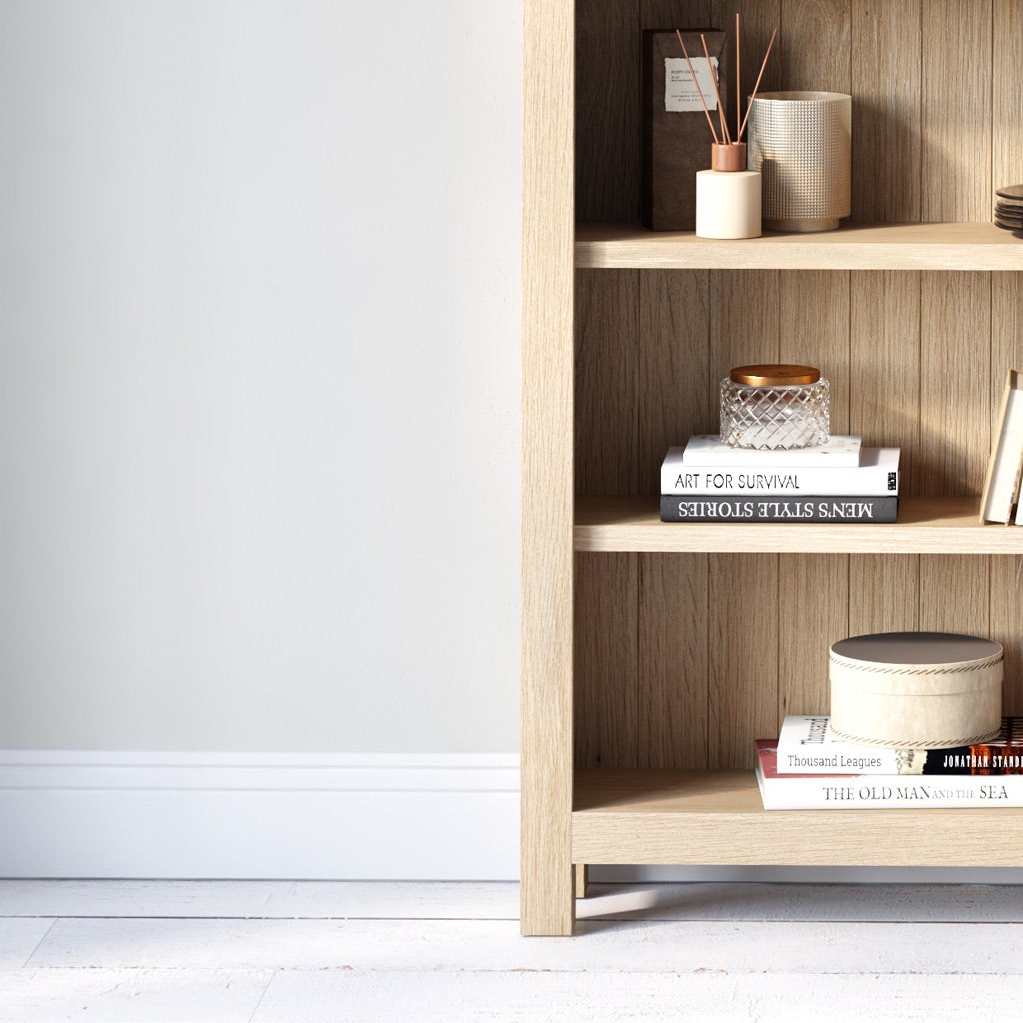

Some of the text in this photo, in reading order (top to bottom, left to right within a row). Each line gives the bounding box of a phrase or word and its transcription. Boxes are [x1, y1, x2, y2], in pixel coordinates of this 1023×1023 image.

[675, 474, 801, 489] ART FOR SURVIVAL
[678, 501, 874, 518] MEN'S STYLE STORIES
[788, 755, 882, 770] Thousand Leagues
[943, 755, 989, 768] JONATHAN
[823, 785, 1009, 800] THE OLD MAN AND THE SEA
